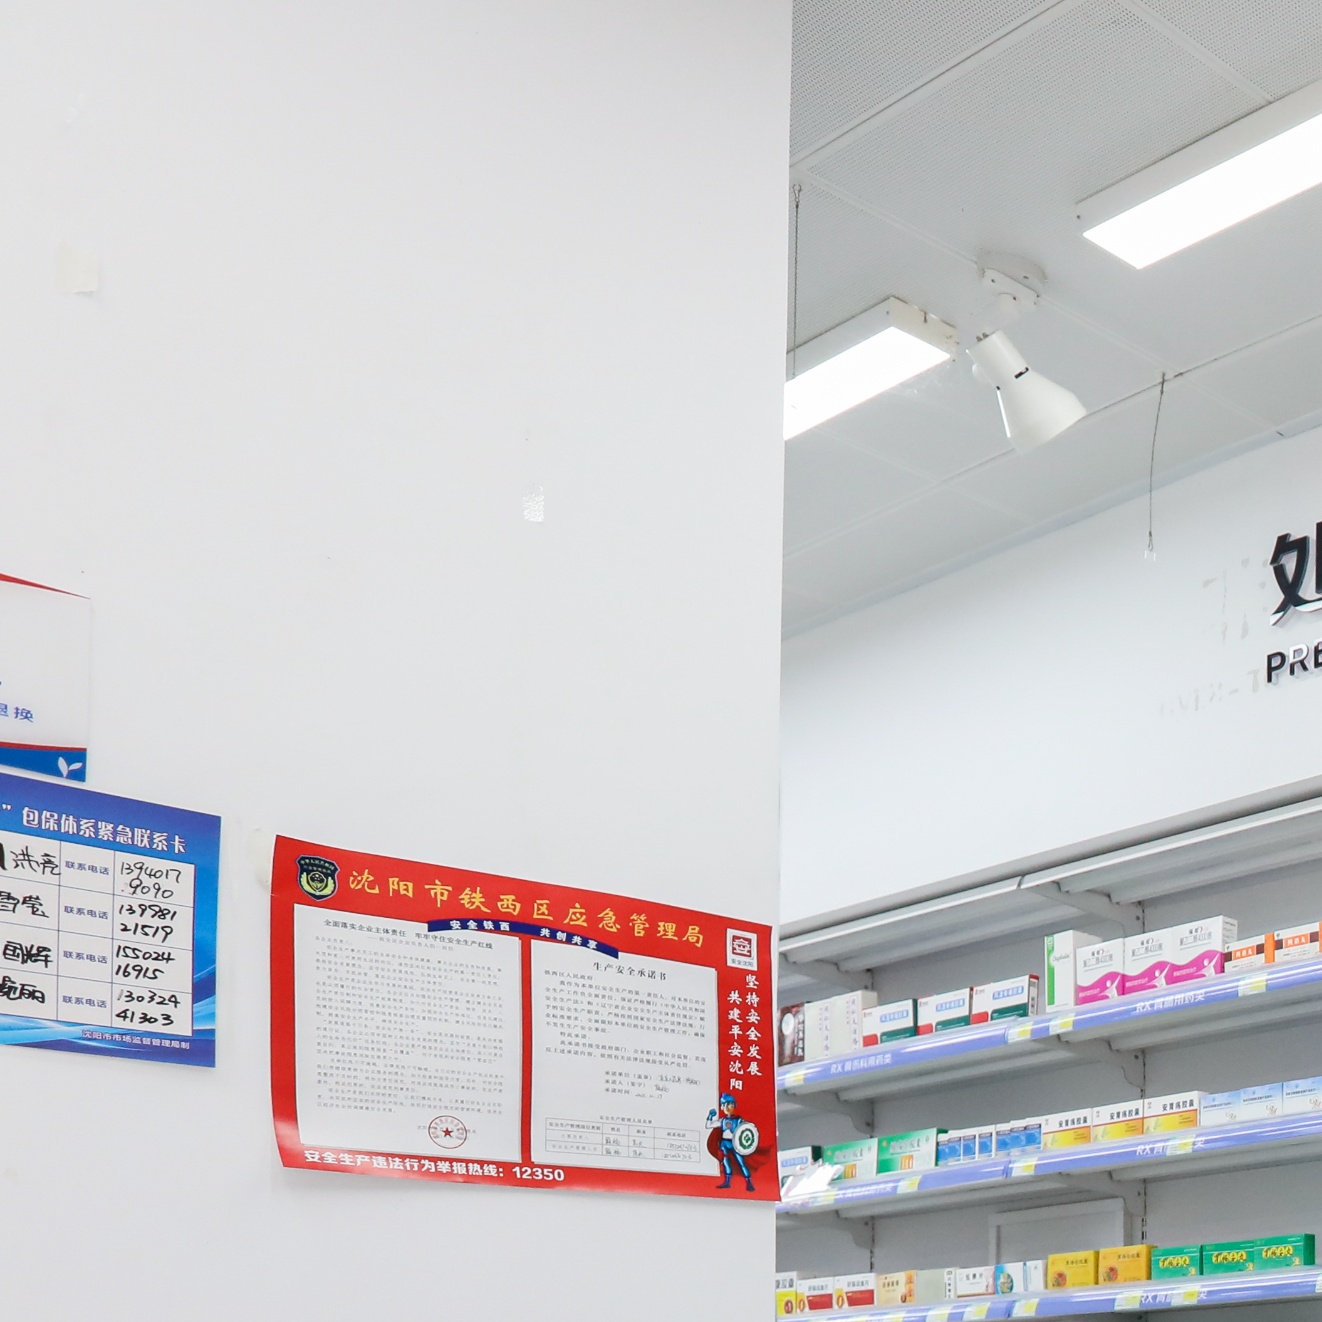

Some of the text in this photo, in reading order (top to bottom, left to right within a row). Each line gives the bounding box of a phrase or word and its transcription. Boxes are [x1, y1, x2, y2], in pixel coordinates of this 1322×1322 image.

[21, 806, 187, 854] 包保体系紧急联系卡
[64, 860, 182, 884] 联系电话 1394017
[129, 877, 174, 899] 9090
[63, 904, 109, 920] 联系电话
[349, 868, 704, 948] 沈阳市铁西区应急管理局
[119, 922, 174, 944] 21519
[449, 919, 599, 950] 安全铁西 共创共享
[62, 950, 108, 965] 联系电话
[115, 944, 176, 965] 155024
[115, 963, 165, 981] 16915
[592, 961, 668, 982] 生产安全承诺书
[61, 988, 181, 1009] 联系电话 130324
[115, 1008, 175, 1027] 41303
[745, 973, 763, 1077] 坚持安全发展
[82, 1028, 191, 1051] 沈阳市市场监督管理局制
[727, 989, 745, 1091] 共建平安沈阳
[303, 1149, 565, 1182] 安全生产违法行为举报热线： 12350
